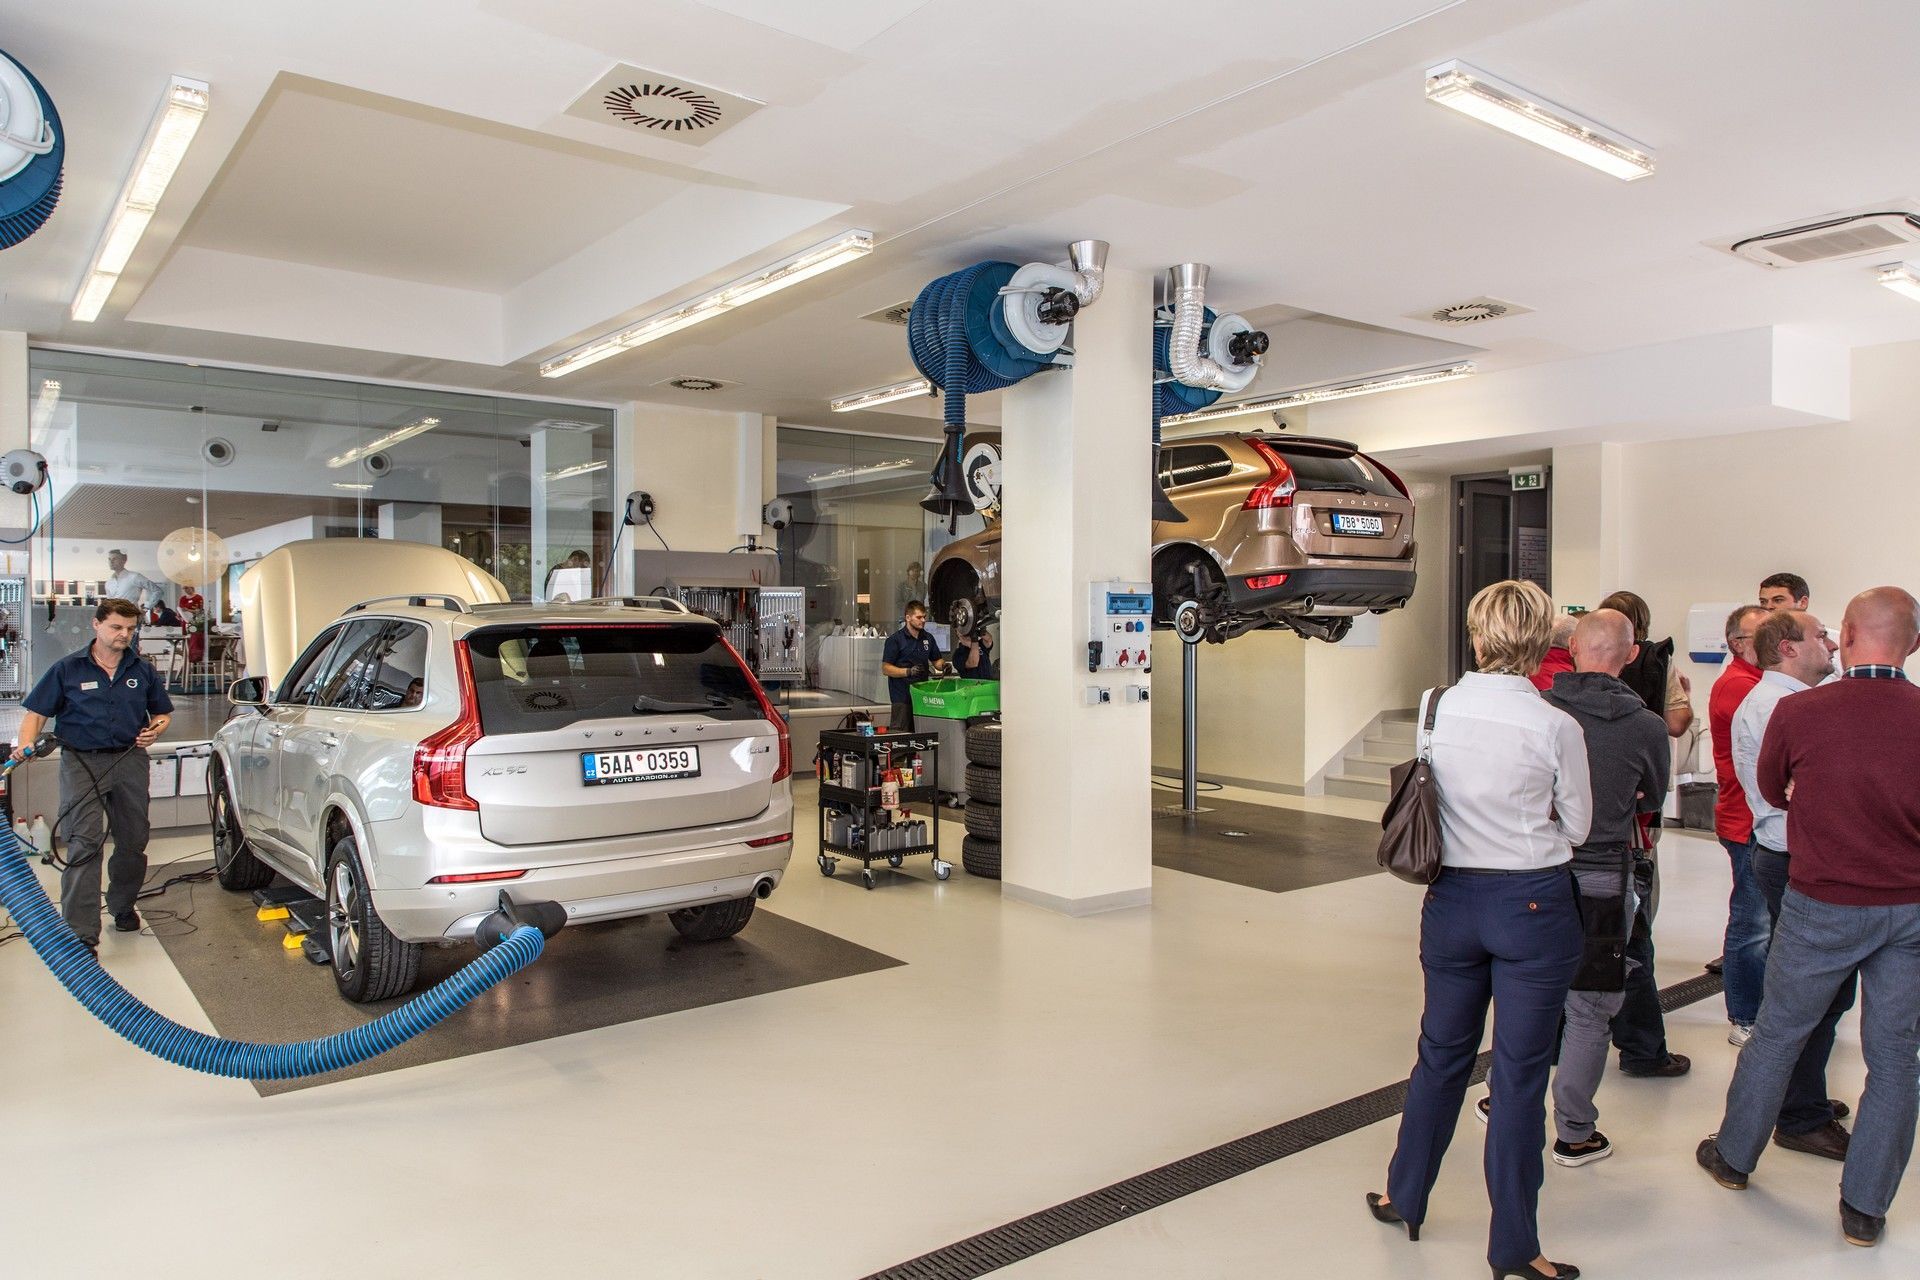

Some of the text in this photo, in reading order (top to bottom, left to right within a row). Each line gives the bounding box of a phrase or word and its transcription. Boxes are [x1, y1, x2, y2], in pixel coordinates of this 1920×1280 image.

[1337, 498, 1389, 508] VOLVO
[1361, 518, 1379, 530] 5060
[929, 697, 945, 705] MEWA
[583, 724, 704, 738] VOLVO
[600, 751, 689, 775] 5AA 0359
